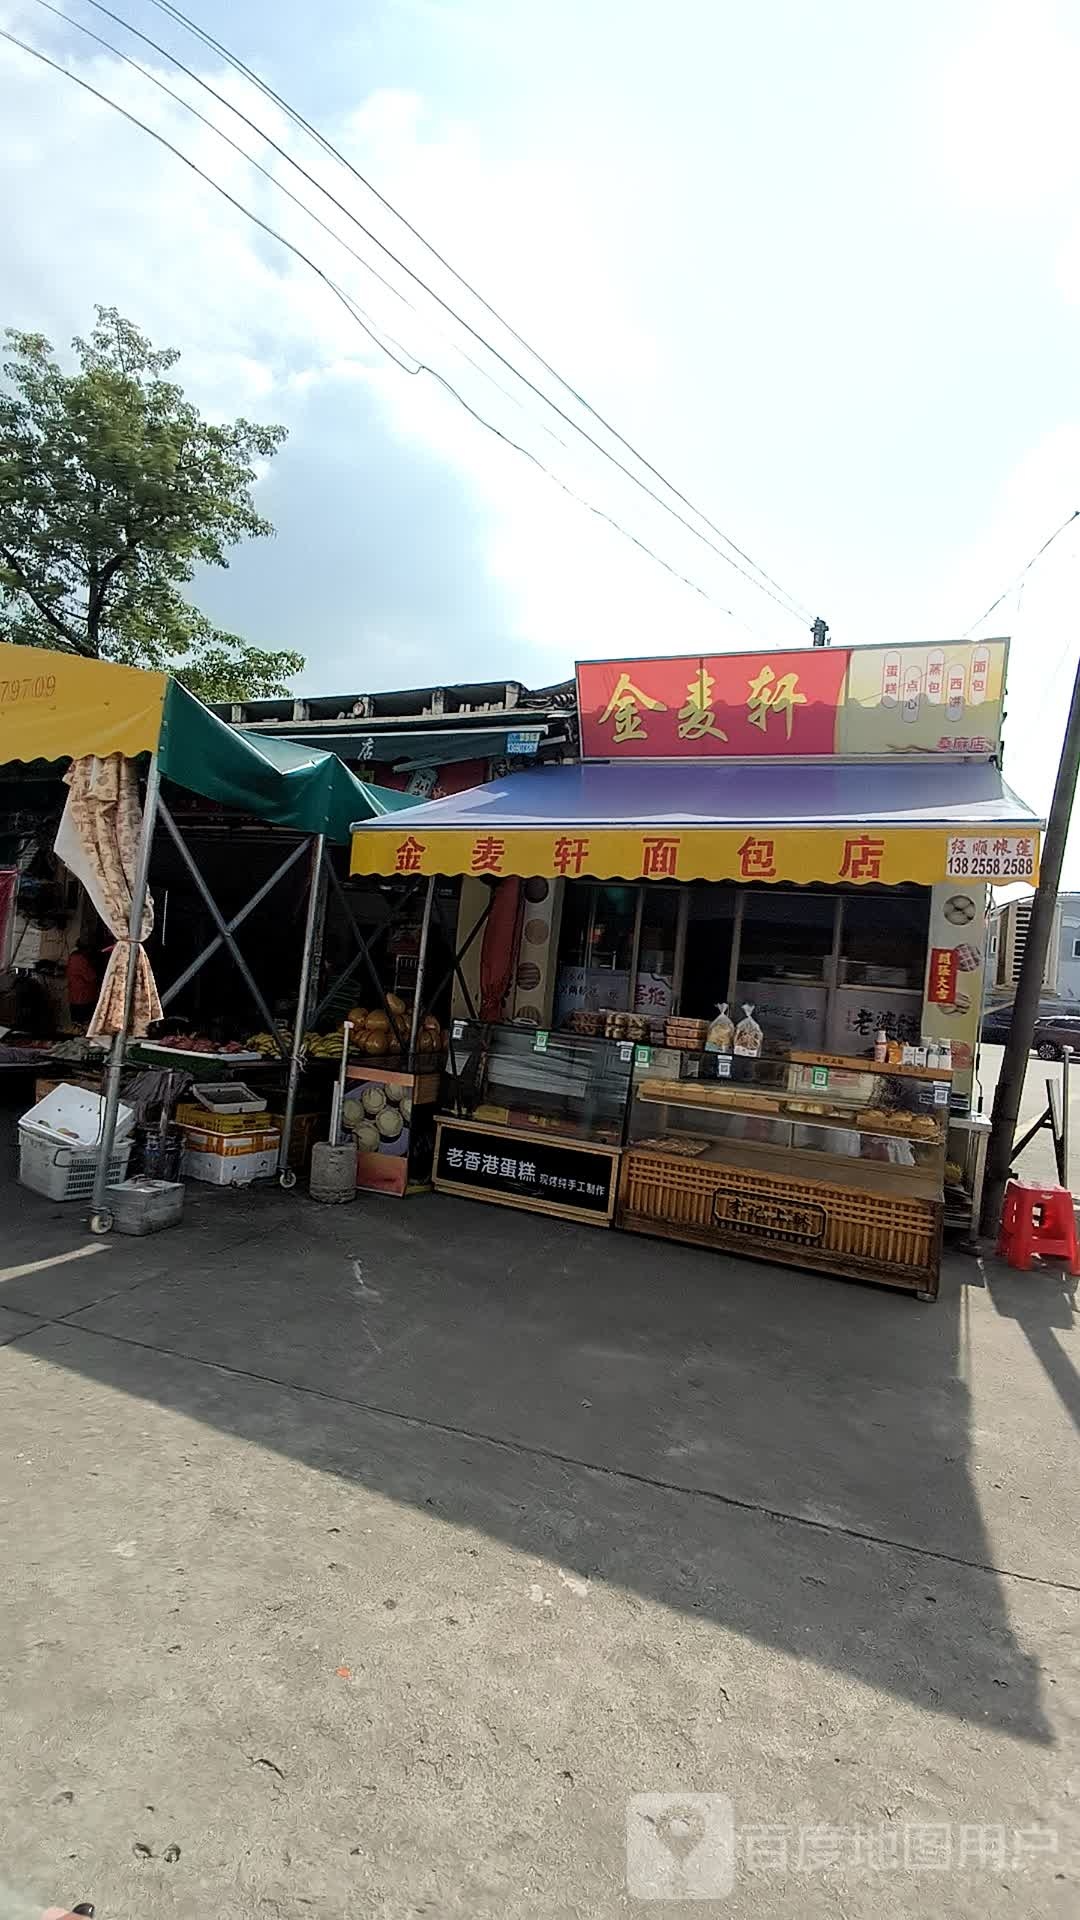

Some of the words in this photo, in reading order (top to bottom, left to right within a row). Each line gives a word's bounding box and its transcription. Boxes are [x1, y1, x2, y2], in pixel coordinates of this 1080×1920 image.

[972, 661, 987, 692] 面包
[904, 680, 919, 710] 点心
[395, 836, 885, 879] 金麦轩面包店
[948, 857, 969, 874] 138
[971, 858, 1000, 875] 2558
[1003, 858, 1033, 875] 2588
[446, 1147, 537, 1183] 老香港蛋糕
